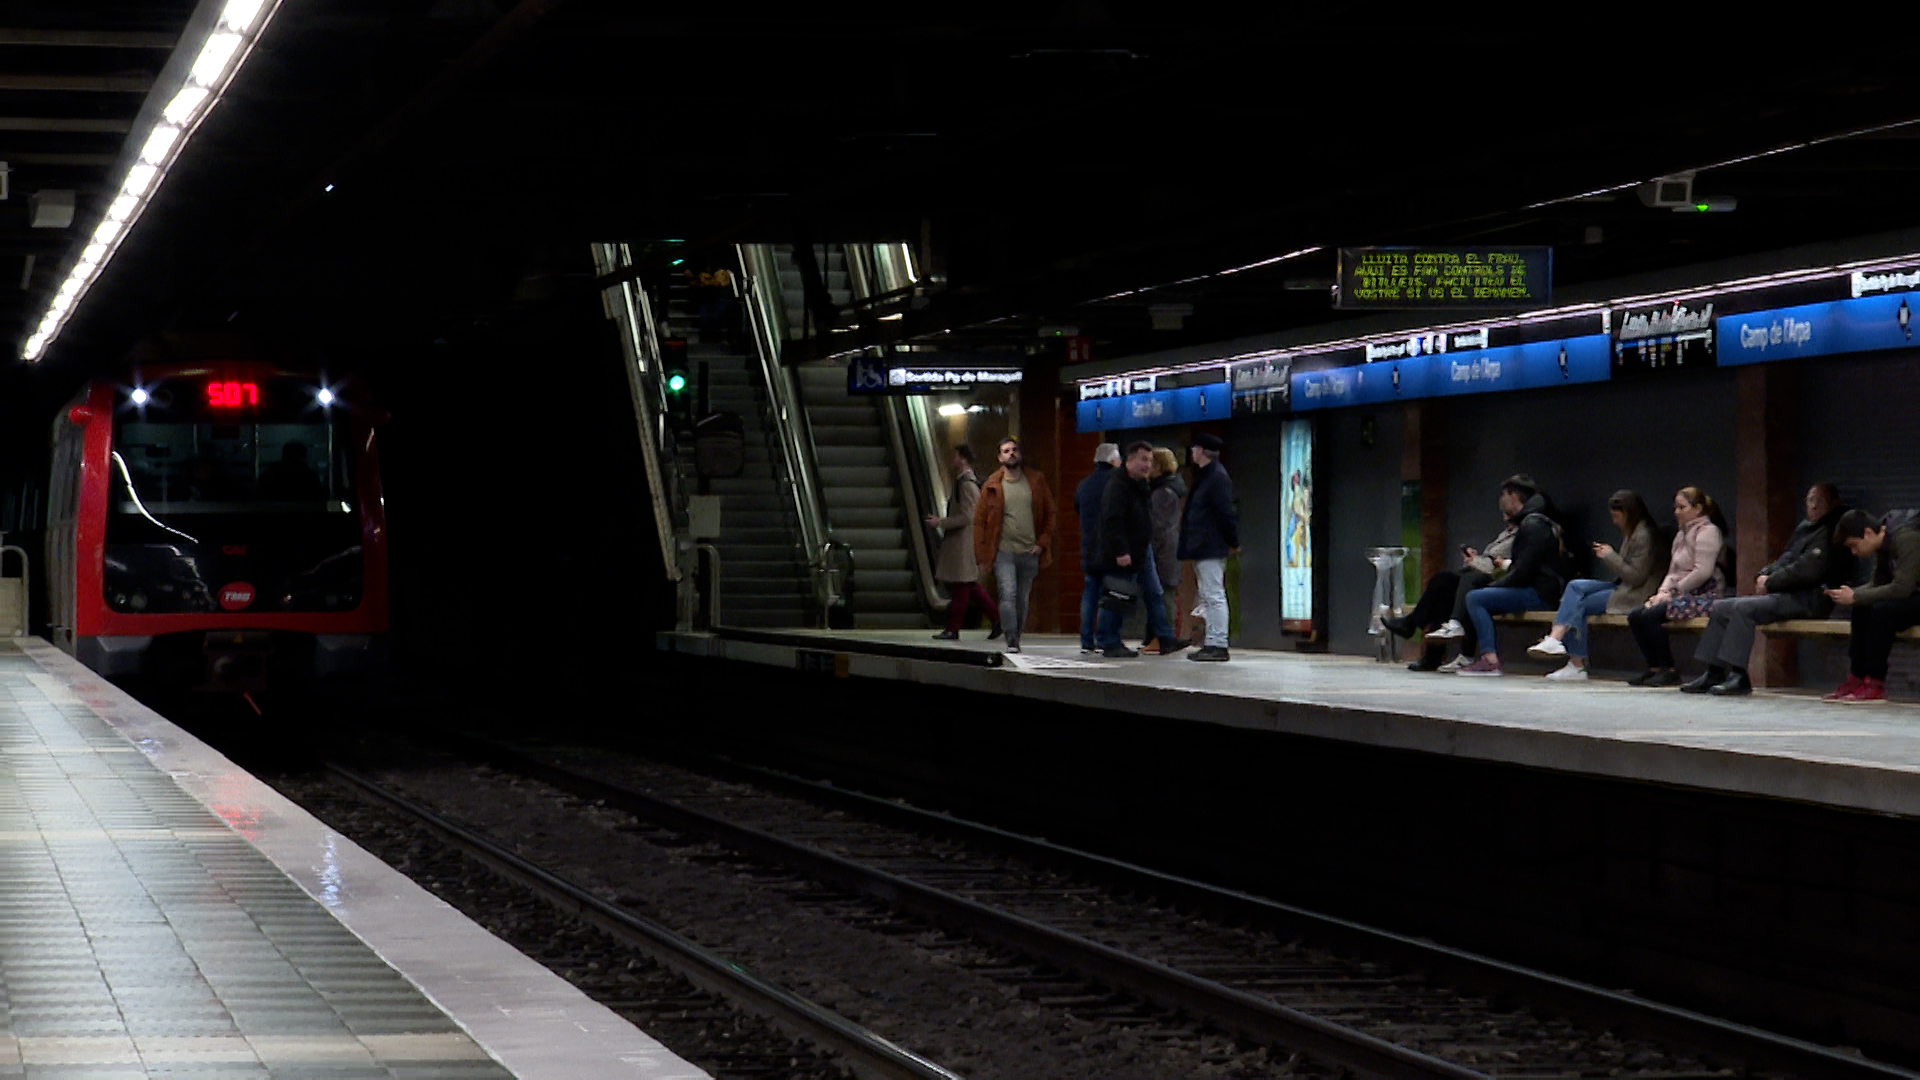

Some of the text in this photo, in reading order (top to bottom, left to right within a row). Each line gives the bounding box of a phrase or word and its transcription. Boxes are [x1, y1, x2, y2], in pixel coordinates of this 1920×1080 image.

[1361, 253, 1526, 265] LLUITA CONTRA EL FRAU.
[1391, 265, 1408, 276] ES
[1444, 265, 1506, 276] CONTROLS
[1510, 277, 1526, 287] EL
[1406, 288, 1423, 299] SI
[1428, 288, 1446, 299] US
[1450, 288, 1469, 299] EL
[1740, 322, 1768, 352] Camp
[1769, 319, 1783, 346] de
[208, 382, 258, 406] 507
